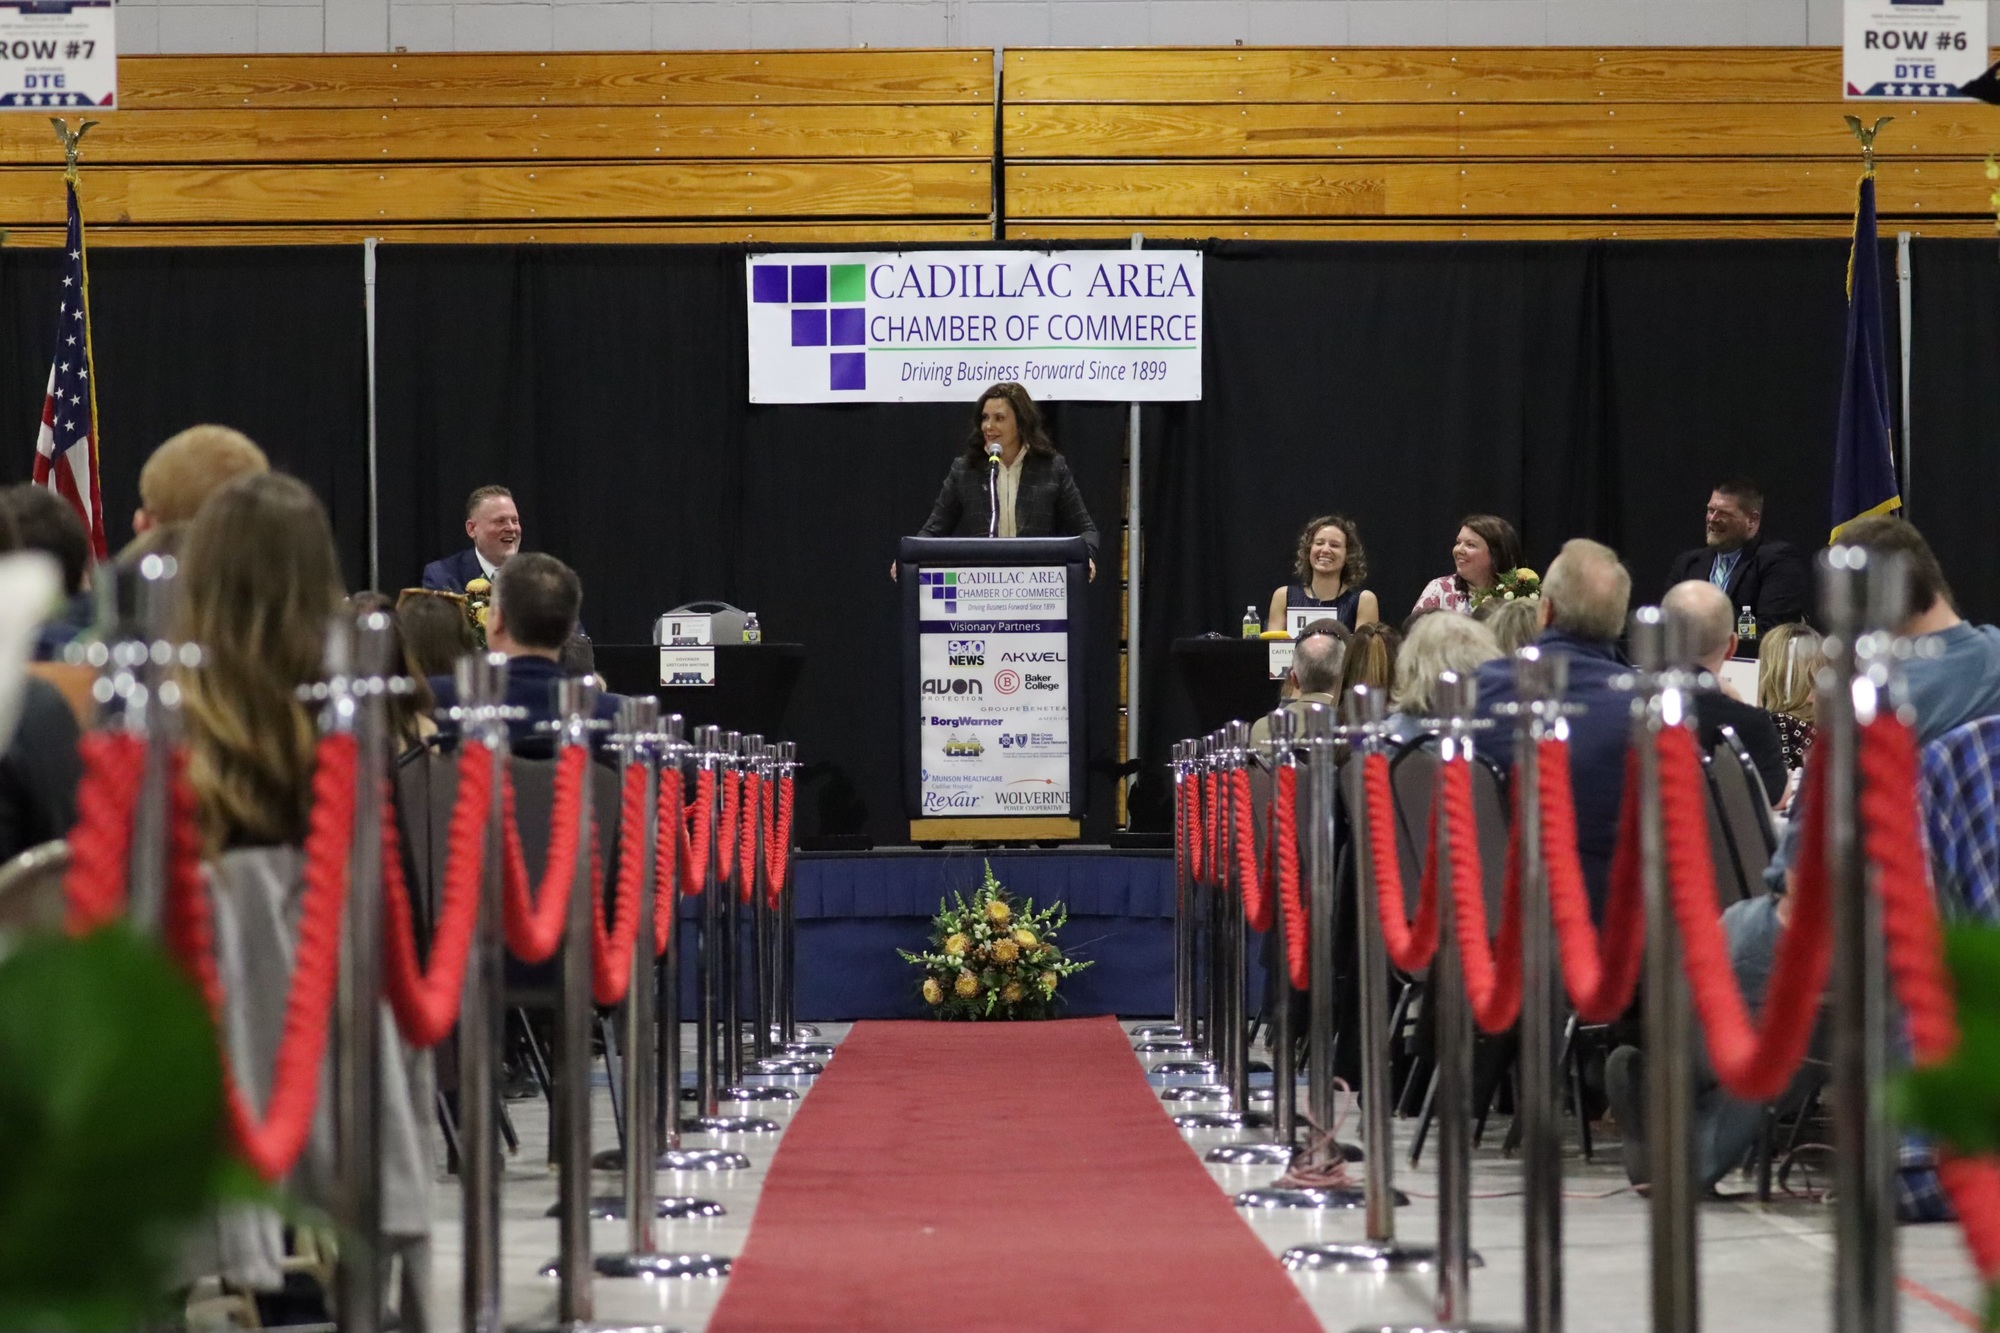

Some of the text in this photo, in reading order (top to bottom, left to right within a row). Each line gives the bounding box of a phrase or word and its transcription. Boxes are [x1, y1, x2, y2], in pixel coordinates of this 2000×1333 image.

[1864, 30, 1967, 51] ROW #6
[65, 40, 96, 60] #7
[1894, 64, 1936, 79] DTE
[24, 74, 66, 89] DTE
[870, 262, 1197, 299] CADILLAC AREA
[870, 314, 1197, 342] CHAMBER OF COMMERCE
[901, 361, 1168, 386] Driving Business Forward Since 1899
[957, 571, 1065, 584] CADILLAC AREA
[957, 587, 1065, 599] CHAMBER OF COMMERCE
[968, 603, 986, 612] Driving
[986, 603, 1007, 611] Business
[1008, 603, 1029, 611] Forward
[1029, 603, 1042, 611] Since
[949, 621, 1041, 633] Visionary Partners
[948, 640, 985, 654] 9&10
[949, 655, 985, 666] NEWS
[1000, 652, 1067, 662] AKWEL
[1025, 674, 1052, 682] Baker
[921, 678, 983, 695] AVON
[1024, 682, 1060, 691] College
[930, 716, 1004, 728] BorgWarner
[931, 774, 962, 782] MUNSON
[923, 791, 980, 812] Rexair
[995, 792, 1071, 804] WOLVERINE
